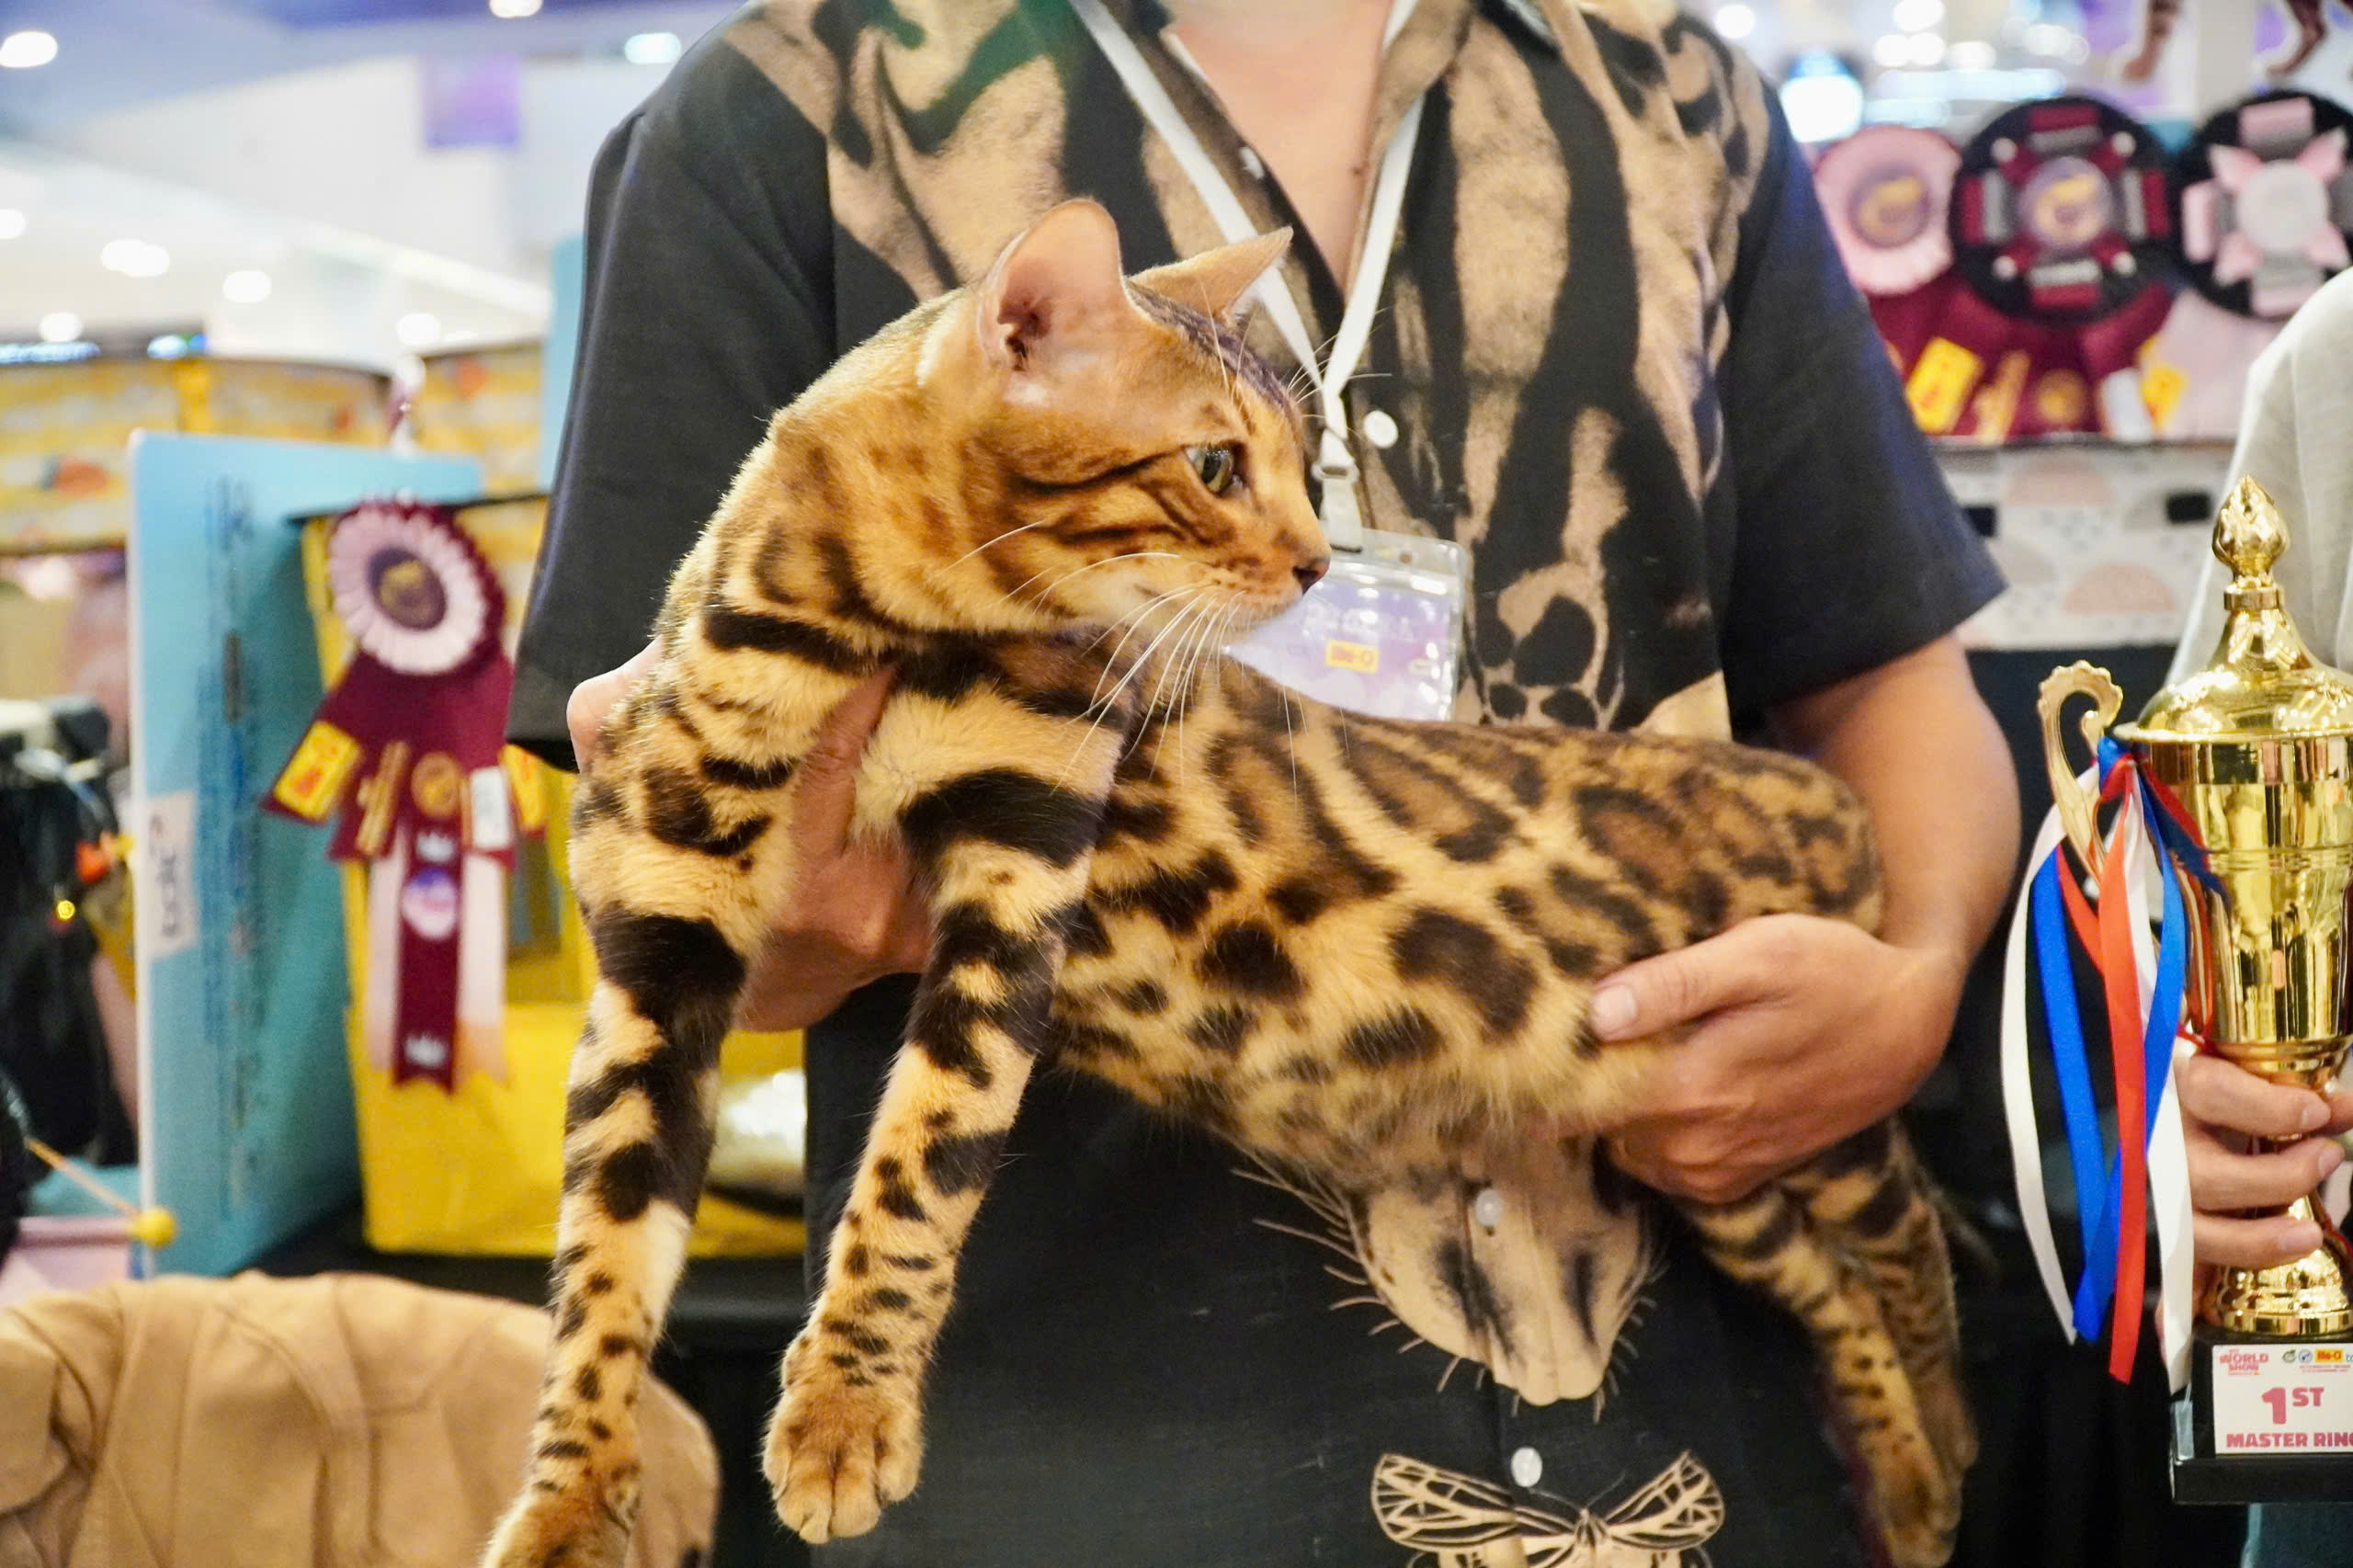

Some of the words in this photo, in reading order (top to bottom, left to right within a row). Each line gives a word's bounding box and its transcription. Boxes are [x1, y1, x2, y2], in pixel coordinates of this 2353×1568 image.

[2220, 1353, 2269, 1363] WORLD
[2228, 1361, 2259, 1370] SHOW
[2261, 1387, 2325, 1425] 1ST
[2226, 1433, 2308, 1448] MASTER
